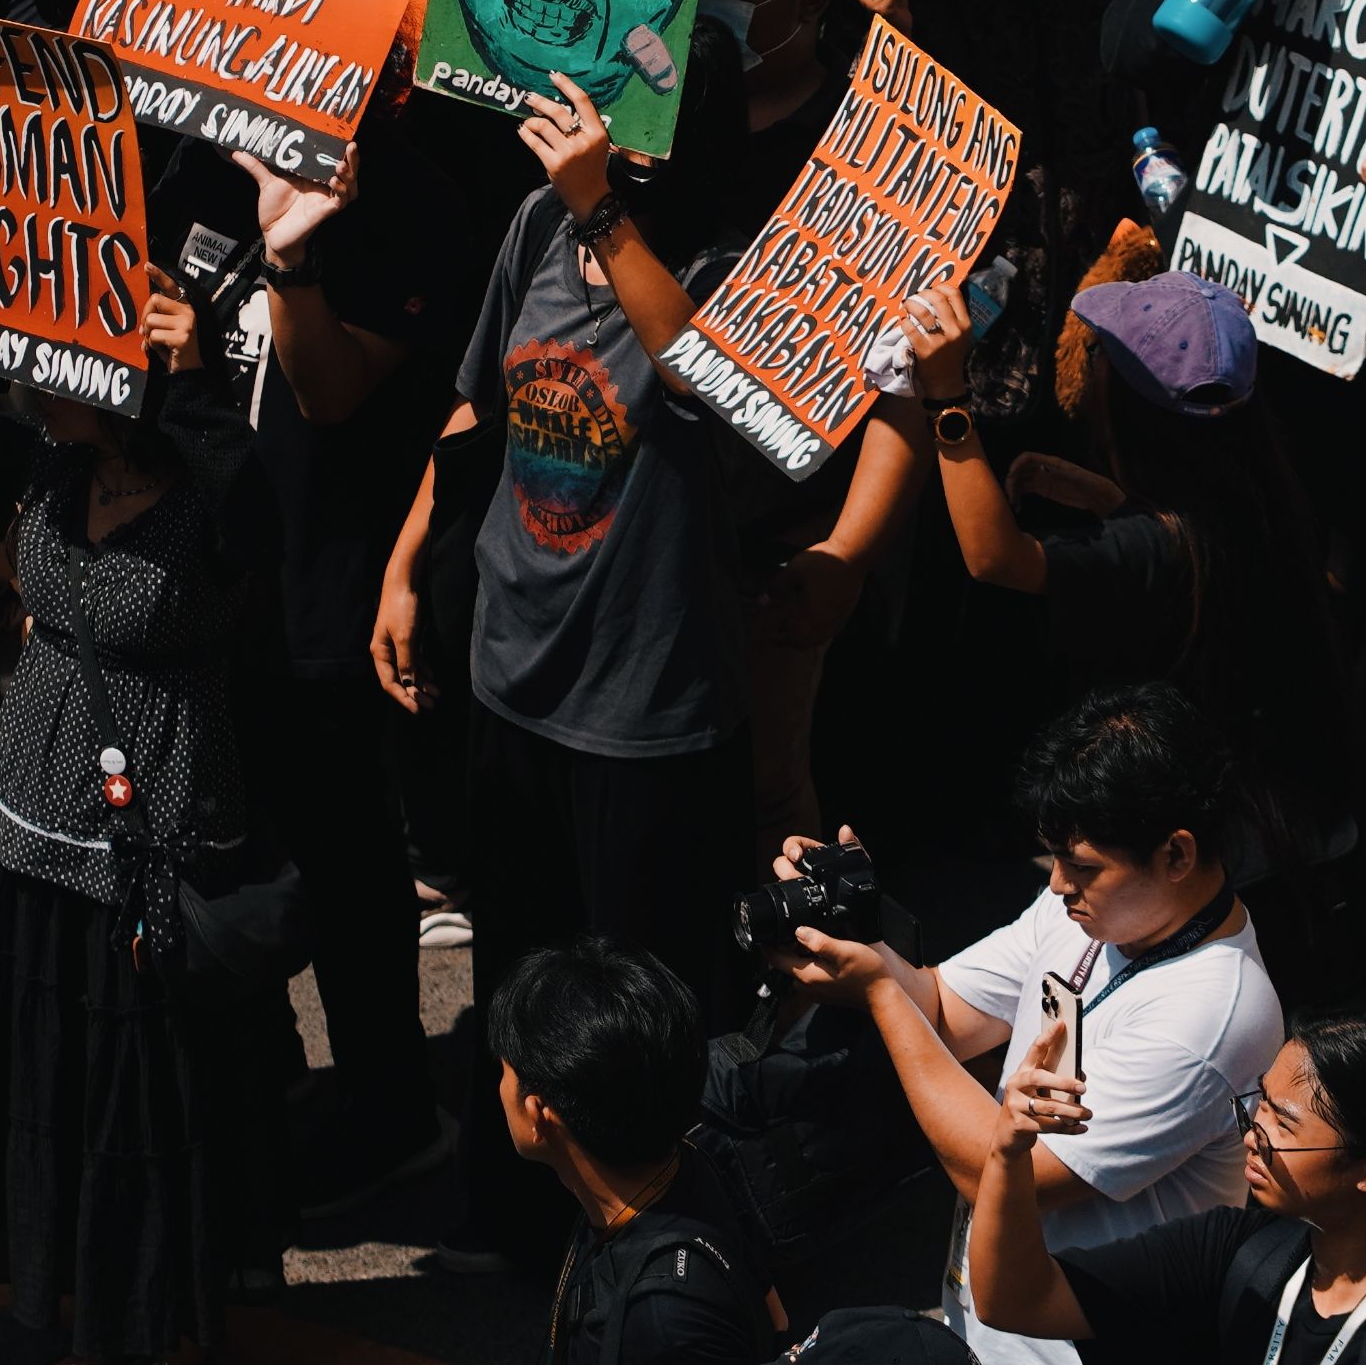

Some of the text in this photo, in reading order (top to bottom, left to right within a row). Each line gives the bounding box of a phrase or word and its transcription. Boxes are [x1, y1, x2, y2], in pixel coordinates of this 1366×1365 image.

[201, 103, 306, 171] SINING
[861, 20, 1019, 192] ISULONG ANG
[819, 86, 1001, 264] MILITANTENG
[191, 232, 228, 256] ANIMAL
[193, 246, 218, 265] NEW
[784, 156, 915, 286] TRADISYON
[728, 212, 903, 372] KABATAAN
[1262, 282, 1352, 356] SINING
[32, 345, 133, 407] SINING
[697, 282, 867, 434] MAKABAYAN
[660, 328, 822, 472] PANDAY SINING
[676, 1247, 687, 1277] ZUKO
[694, 1236, 731, 1270] SONY
